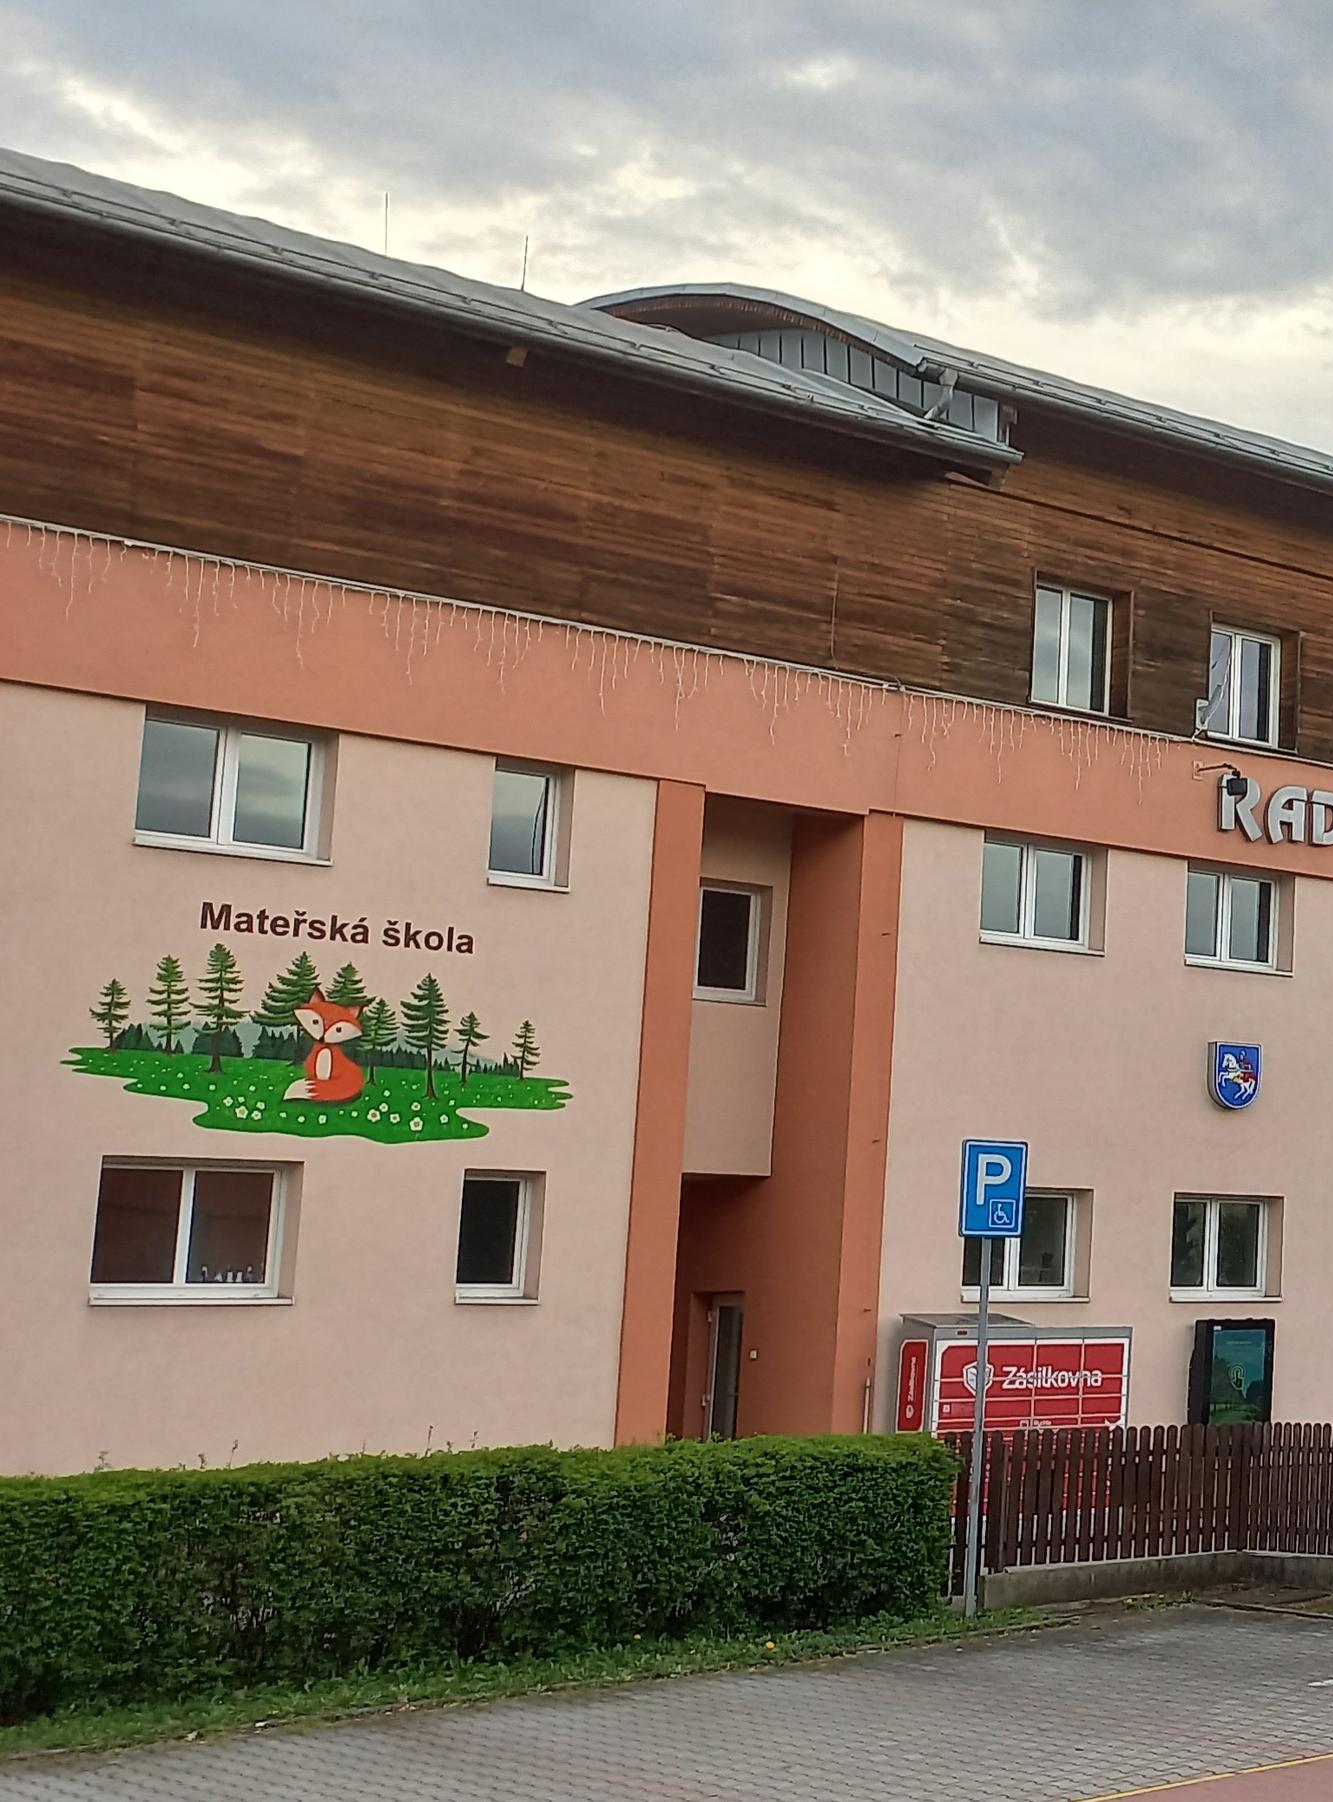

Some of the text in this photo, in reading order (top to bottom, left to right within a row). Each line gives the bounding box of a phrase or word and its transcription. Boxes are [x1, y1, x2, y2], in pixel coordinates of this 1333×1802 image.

[200, 901, 474, 955] Mateřská škola
[976, 1153, 1012, 1205] P
[1001, 1366, 1103, 1389] Zásilkovna
